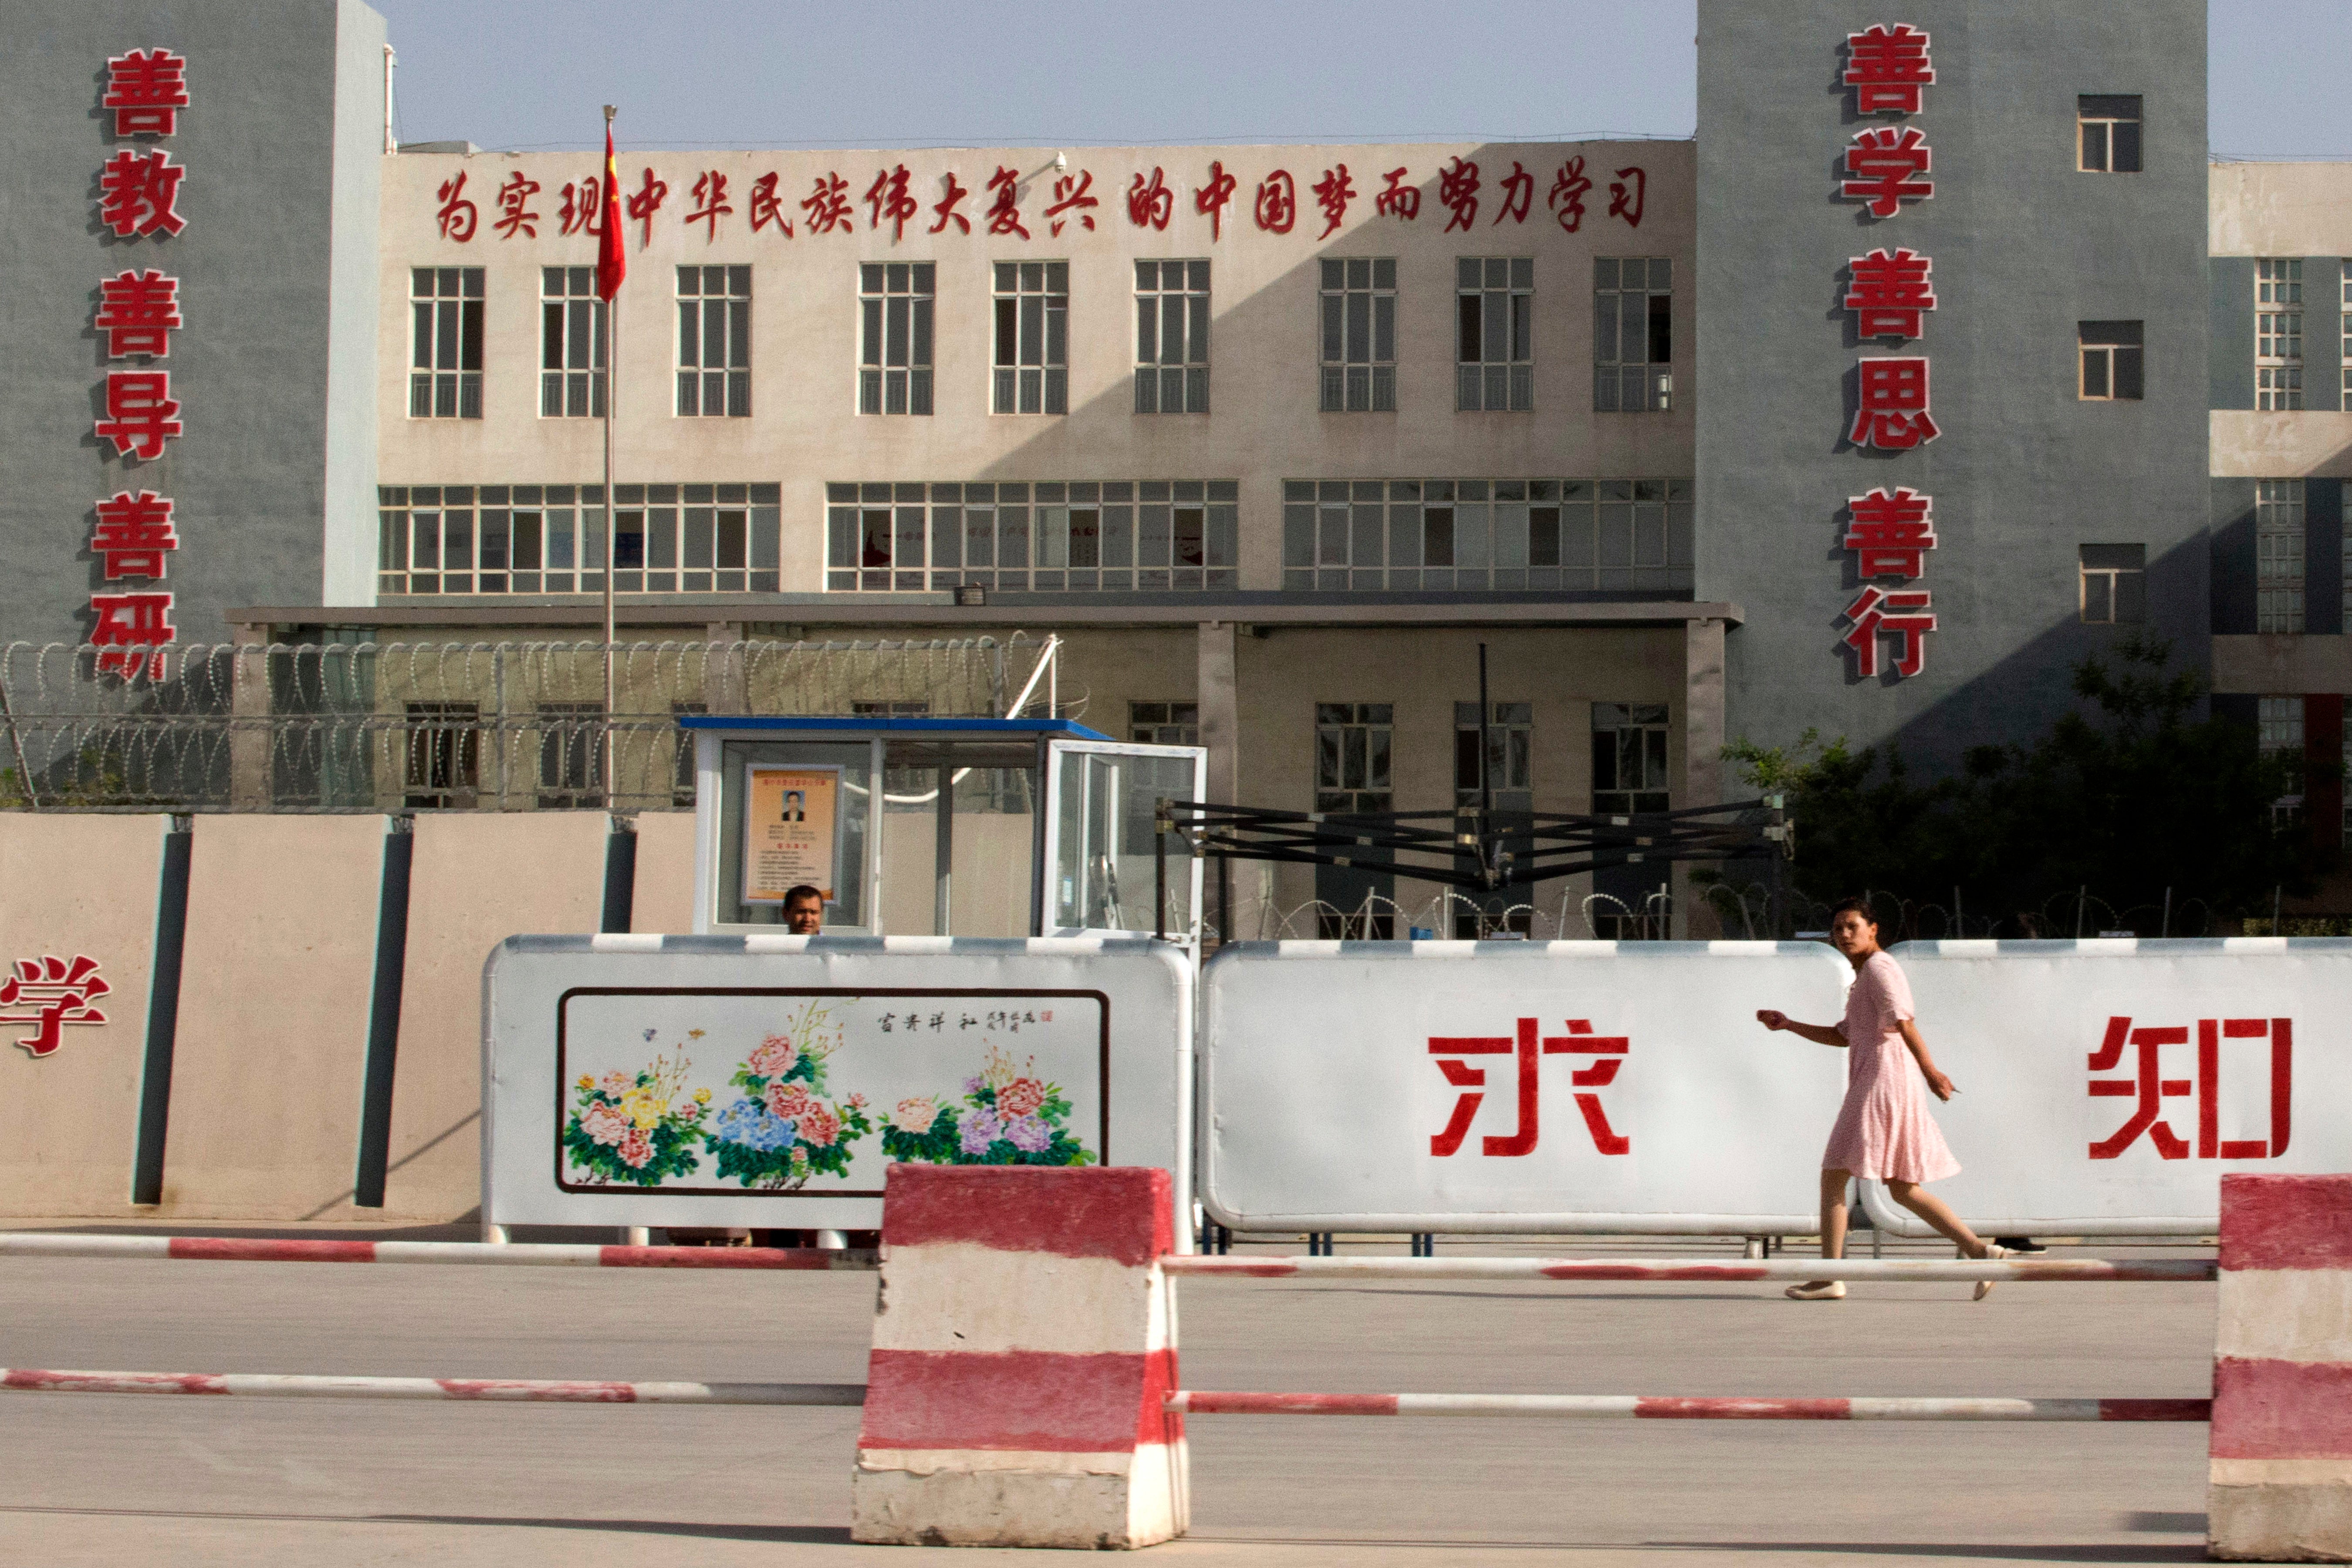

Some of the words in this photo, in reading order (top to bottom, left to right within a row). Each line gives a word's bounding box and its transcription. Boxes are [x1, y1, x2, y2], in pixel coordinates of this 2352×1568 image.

[436, 152, 1646, 249] 为实现中华民族伟大复兴的中国梦而努力学习
[90, 47, 189, 682] 善教善导善研
[1843, 23, 1940, 677] 善学善思善行
[0, 954, 112, 1056] 学
[1427, 1017, 1631, 1157] 求
[2088, 1016, 2292, 1160] 知
